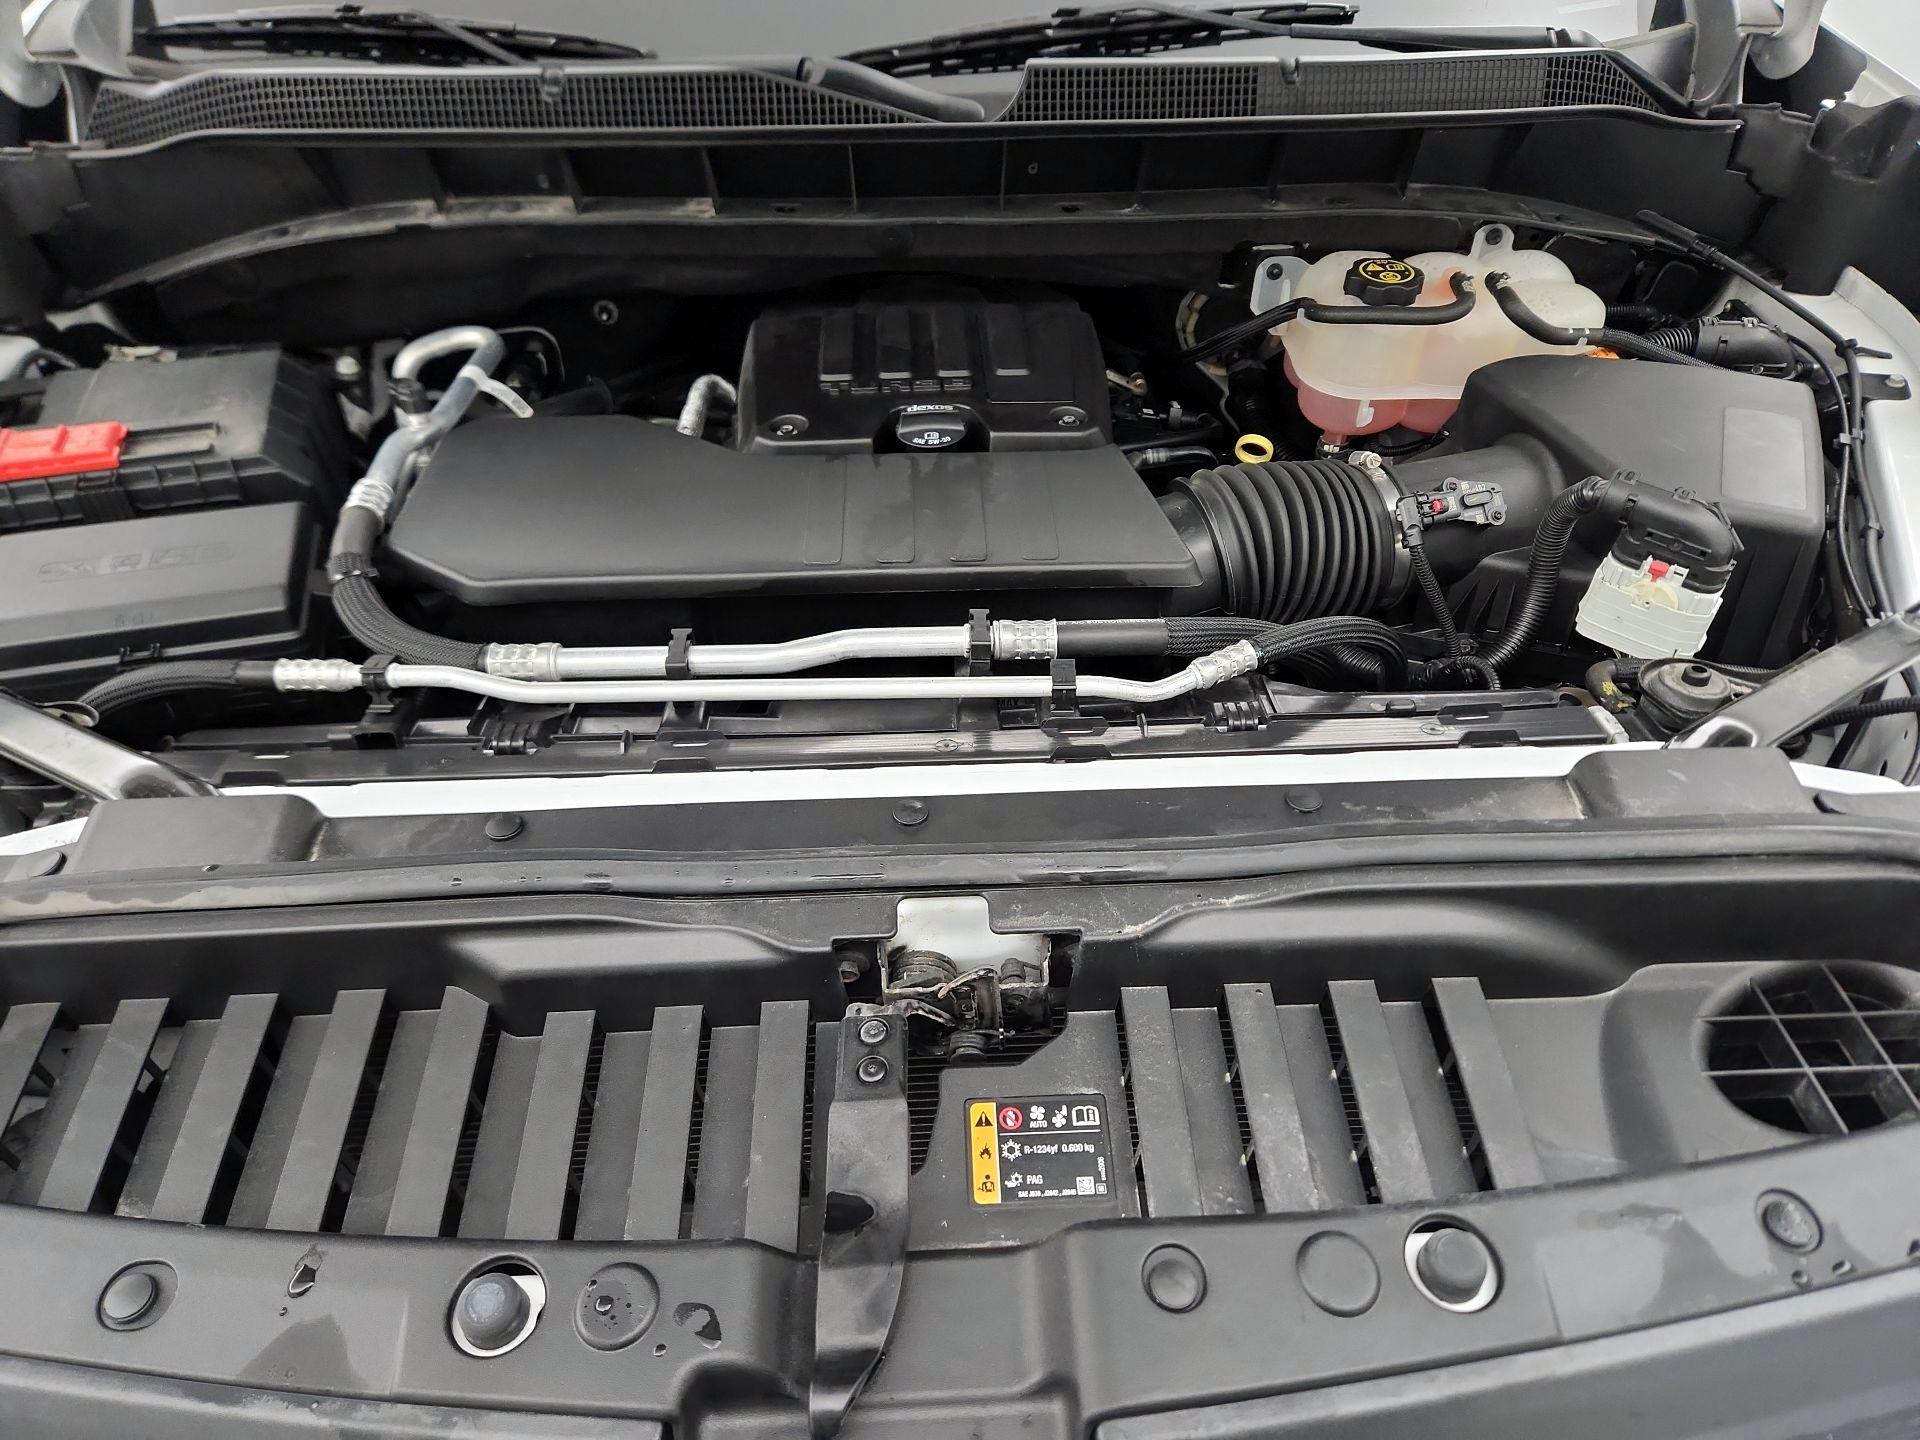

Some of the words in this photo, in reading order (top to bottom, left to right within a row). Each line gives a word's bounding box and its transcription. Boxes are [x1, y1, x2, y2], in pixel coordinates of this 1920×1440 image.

[1029, 1120, 1048, 1128] AUTO
[1023, 1144, 1058, 1155] R-1234yf
[1061, 1143, 1083, 1153] 0.600
[1084, 1142, 1095, 1153] kg
[1026, 1174, 1043, 1185] PAG
